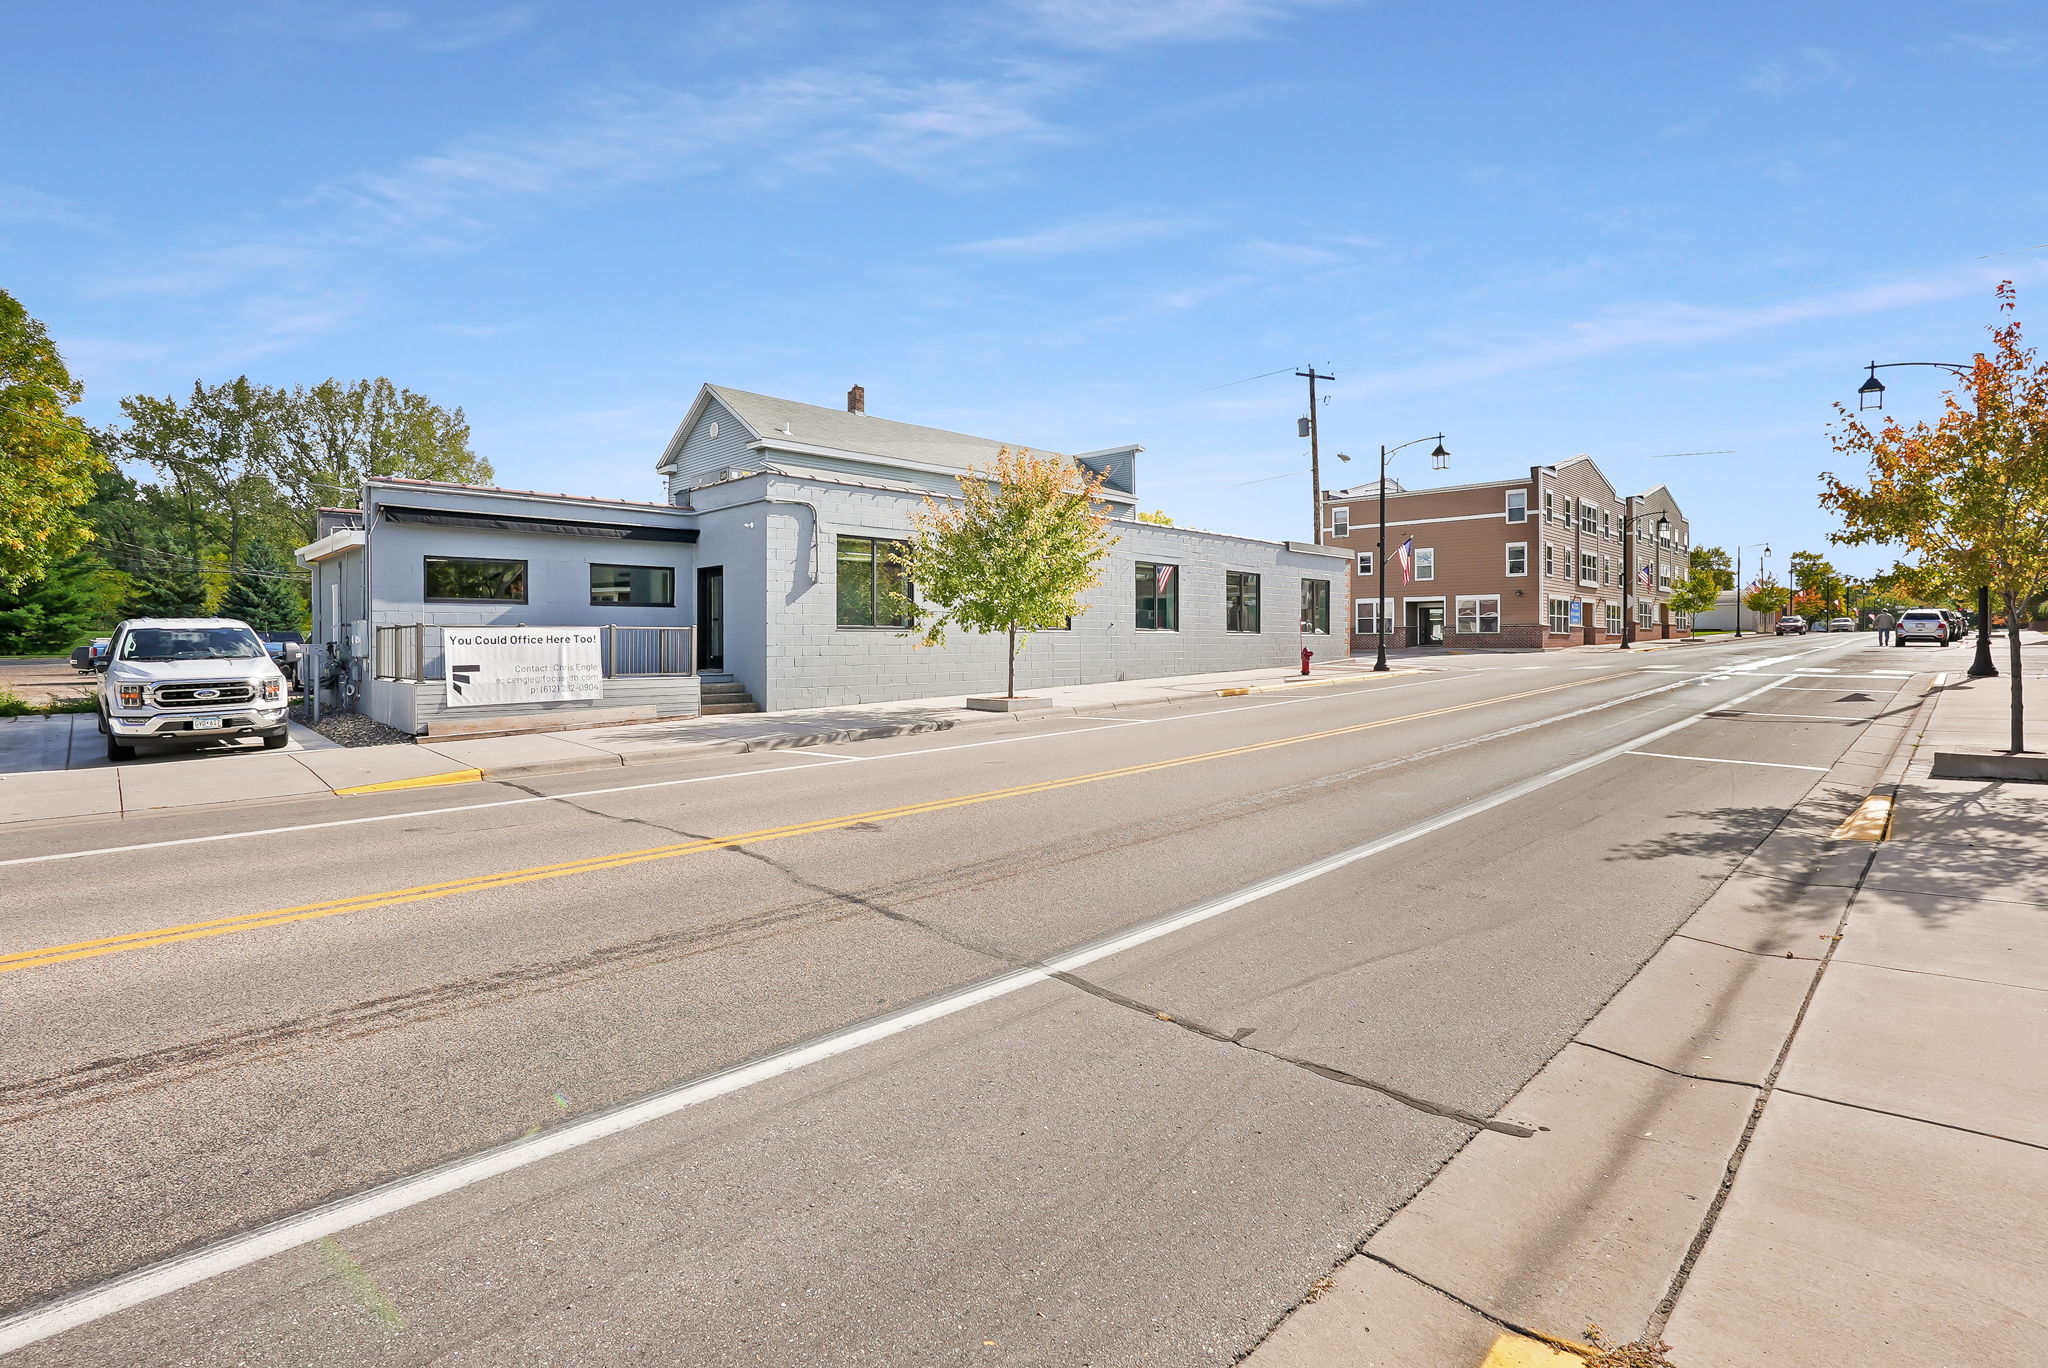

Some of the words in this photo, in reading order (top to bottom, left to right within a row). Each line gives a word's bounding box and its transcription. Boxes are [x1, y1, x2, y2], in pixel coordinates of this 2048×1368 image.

[449, 635, 471, 645] You
[475, 635, 507, 645] Could
[510, 635, 544, 645] Office
[546, 635, 571, 644] Here
[573, 634, 596, 644] Too!
[514, 664, 551, 673] Contact:
[553, 663, 574, 672] Chris
[575, 663, 598, 673] Engle
